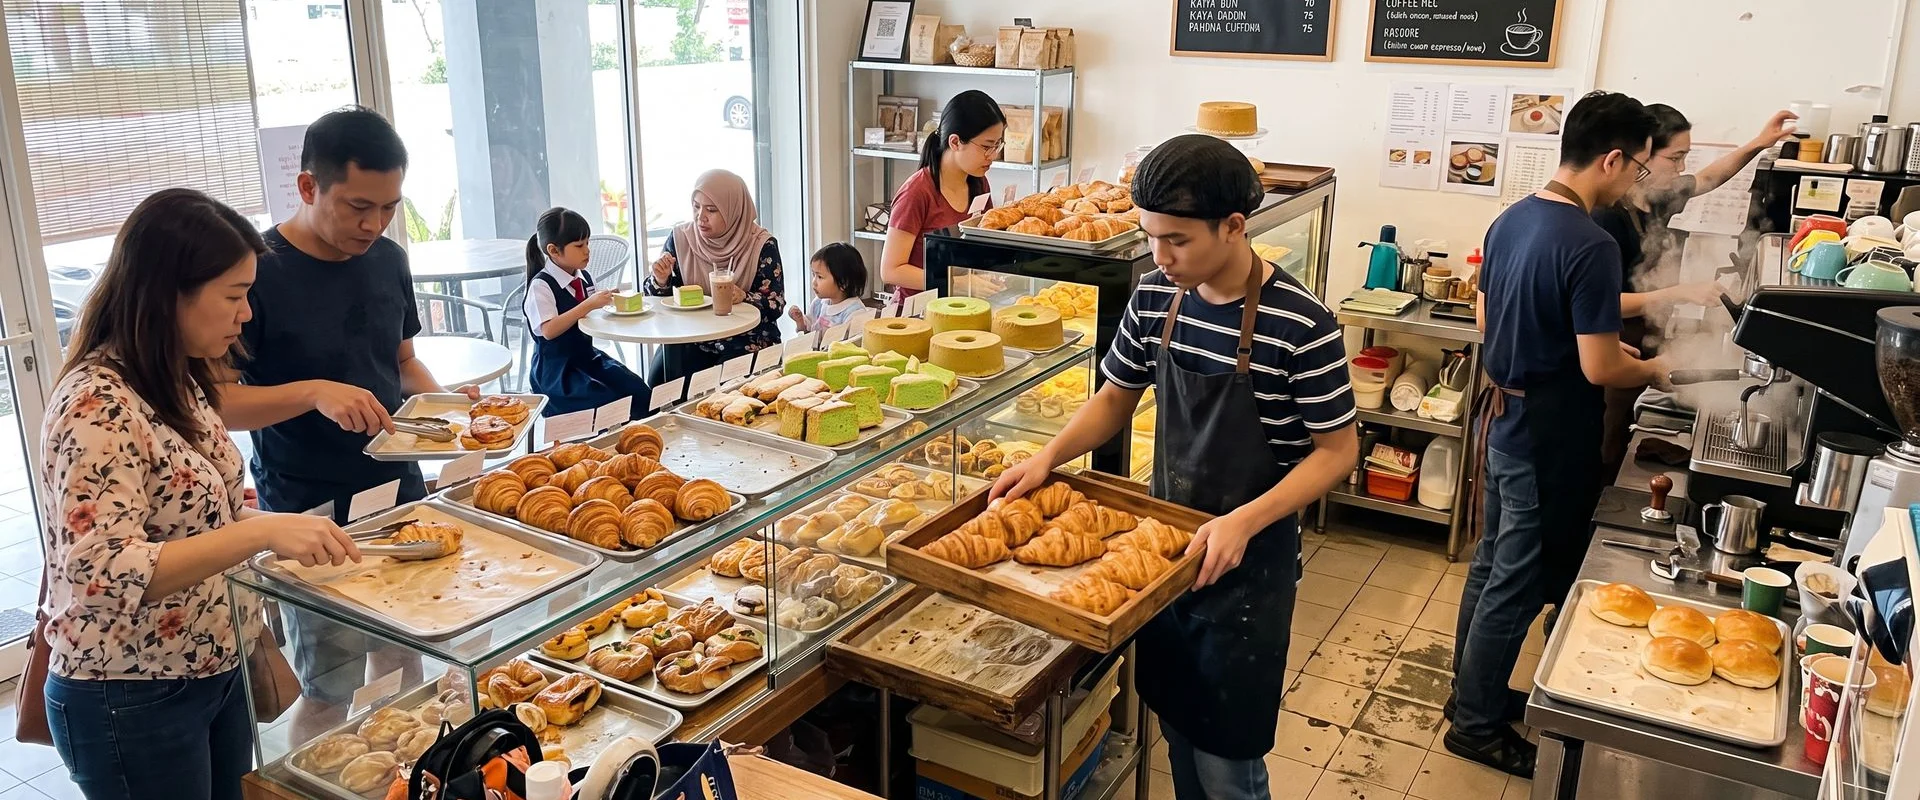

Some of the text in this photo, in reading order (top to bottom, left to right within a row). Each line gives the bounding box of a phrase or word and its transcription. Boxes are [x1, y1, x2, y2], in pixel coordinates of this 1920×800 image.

[1220, 0, 1238, 9] BUN
[1189, 10, 1214, 20] KAYA
[1303, 11, 1314, 20] 75
[1302, 24, 1313, 33] 75
